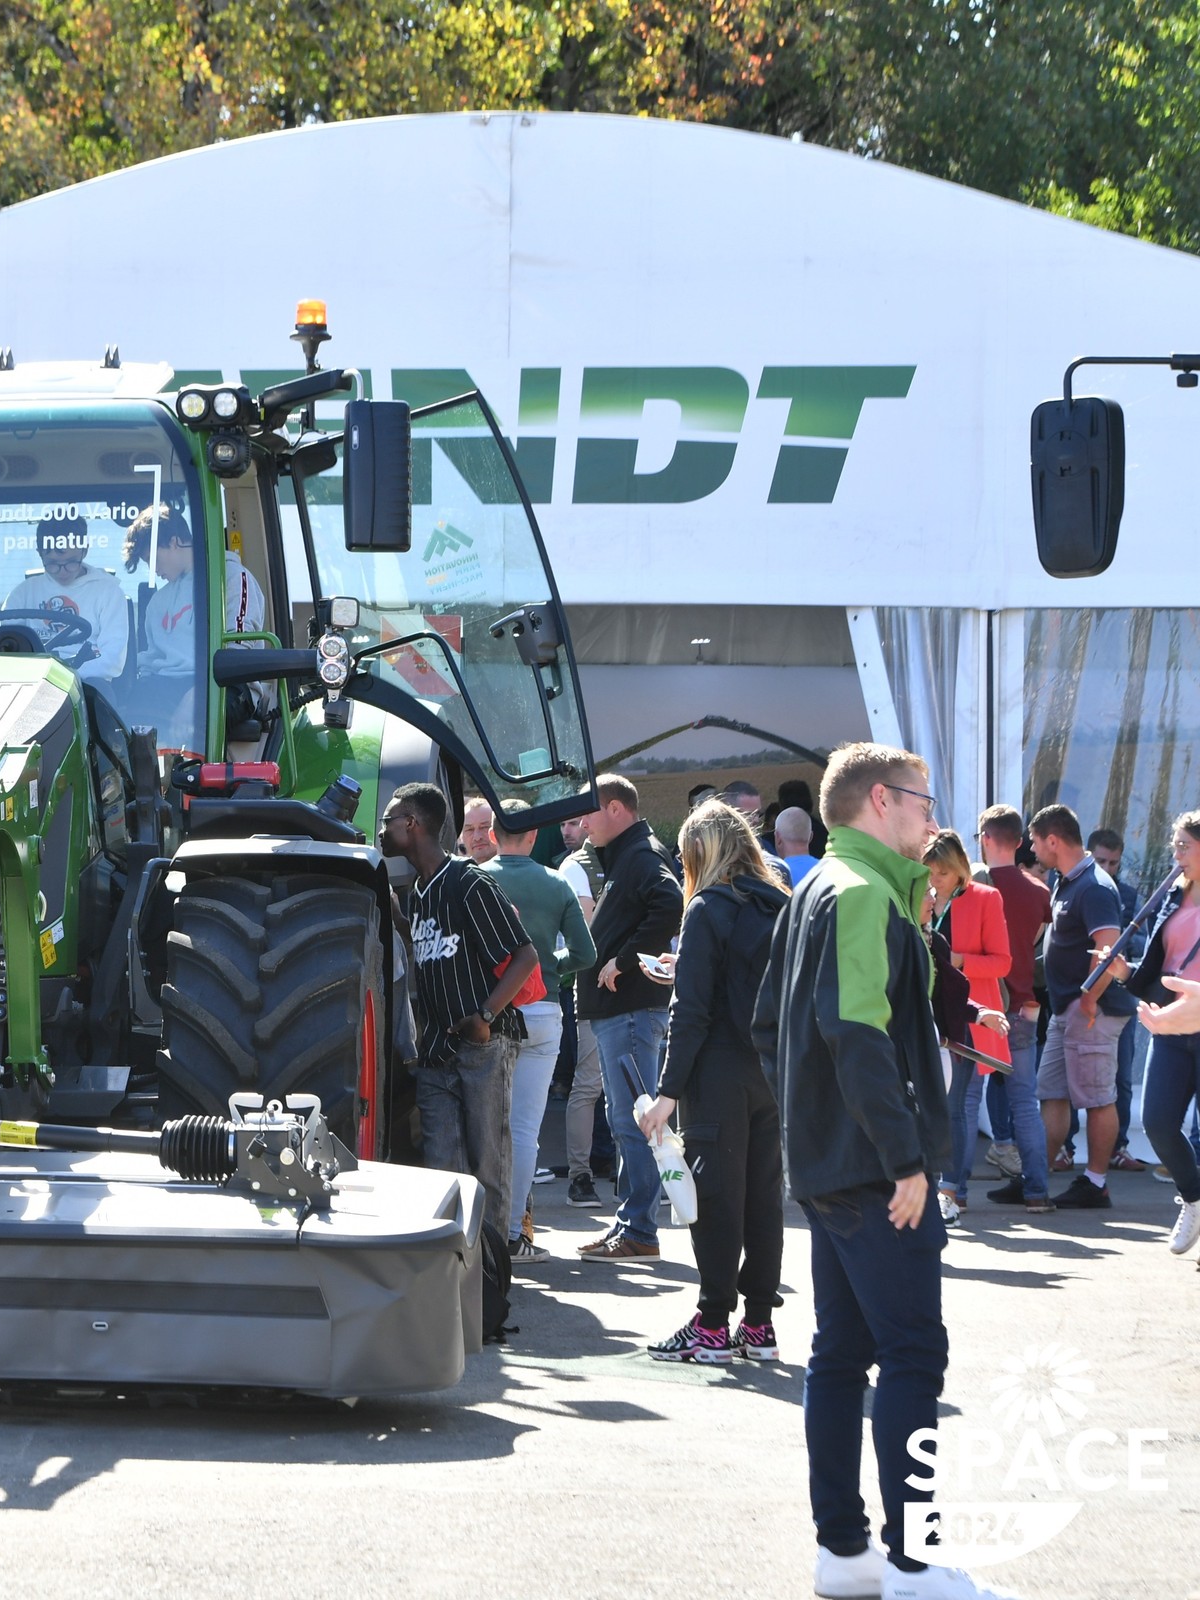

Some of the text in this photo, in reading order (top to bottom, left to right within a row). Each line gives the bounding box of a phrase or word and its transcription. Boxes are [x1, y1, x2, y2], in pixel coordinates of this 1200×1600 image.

[165, 366, 918, 505] NDT
[40, 503, 79, 521] 600
[85, 501, 140, 520] Vario
[3, 535, 38, 555] par
[42, 532, 109, 550] nature
[413, 928, 461, 969] geles
